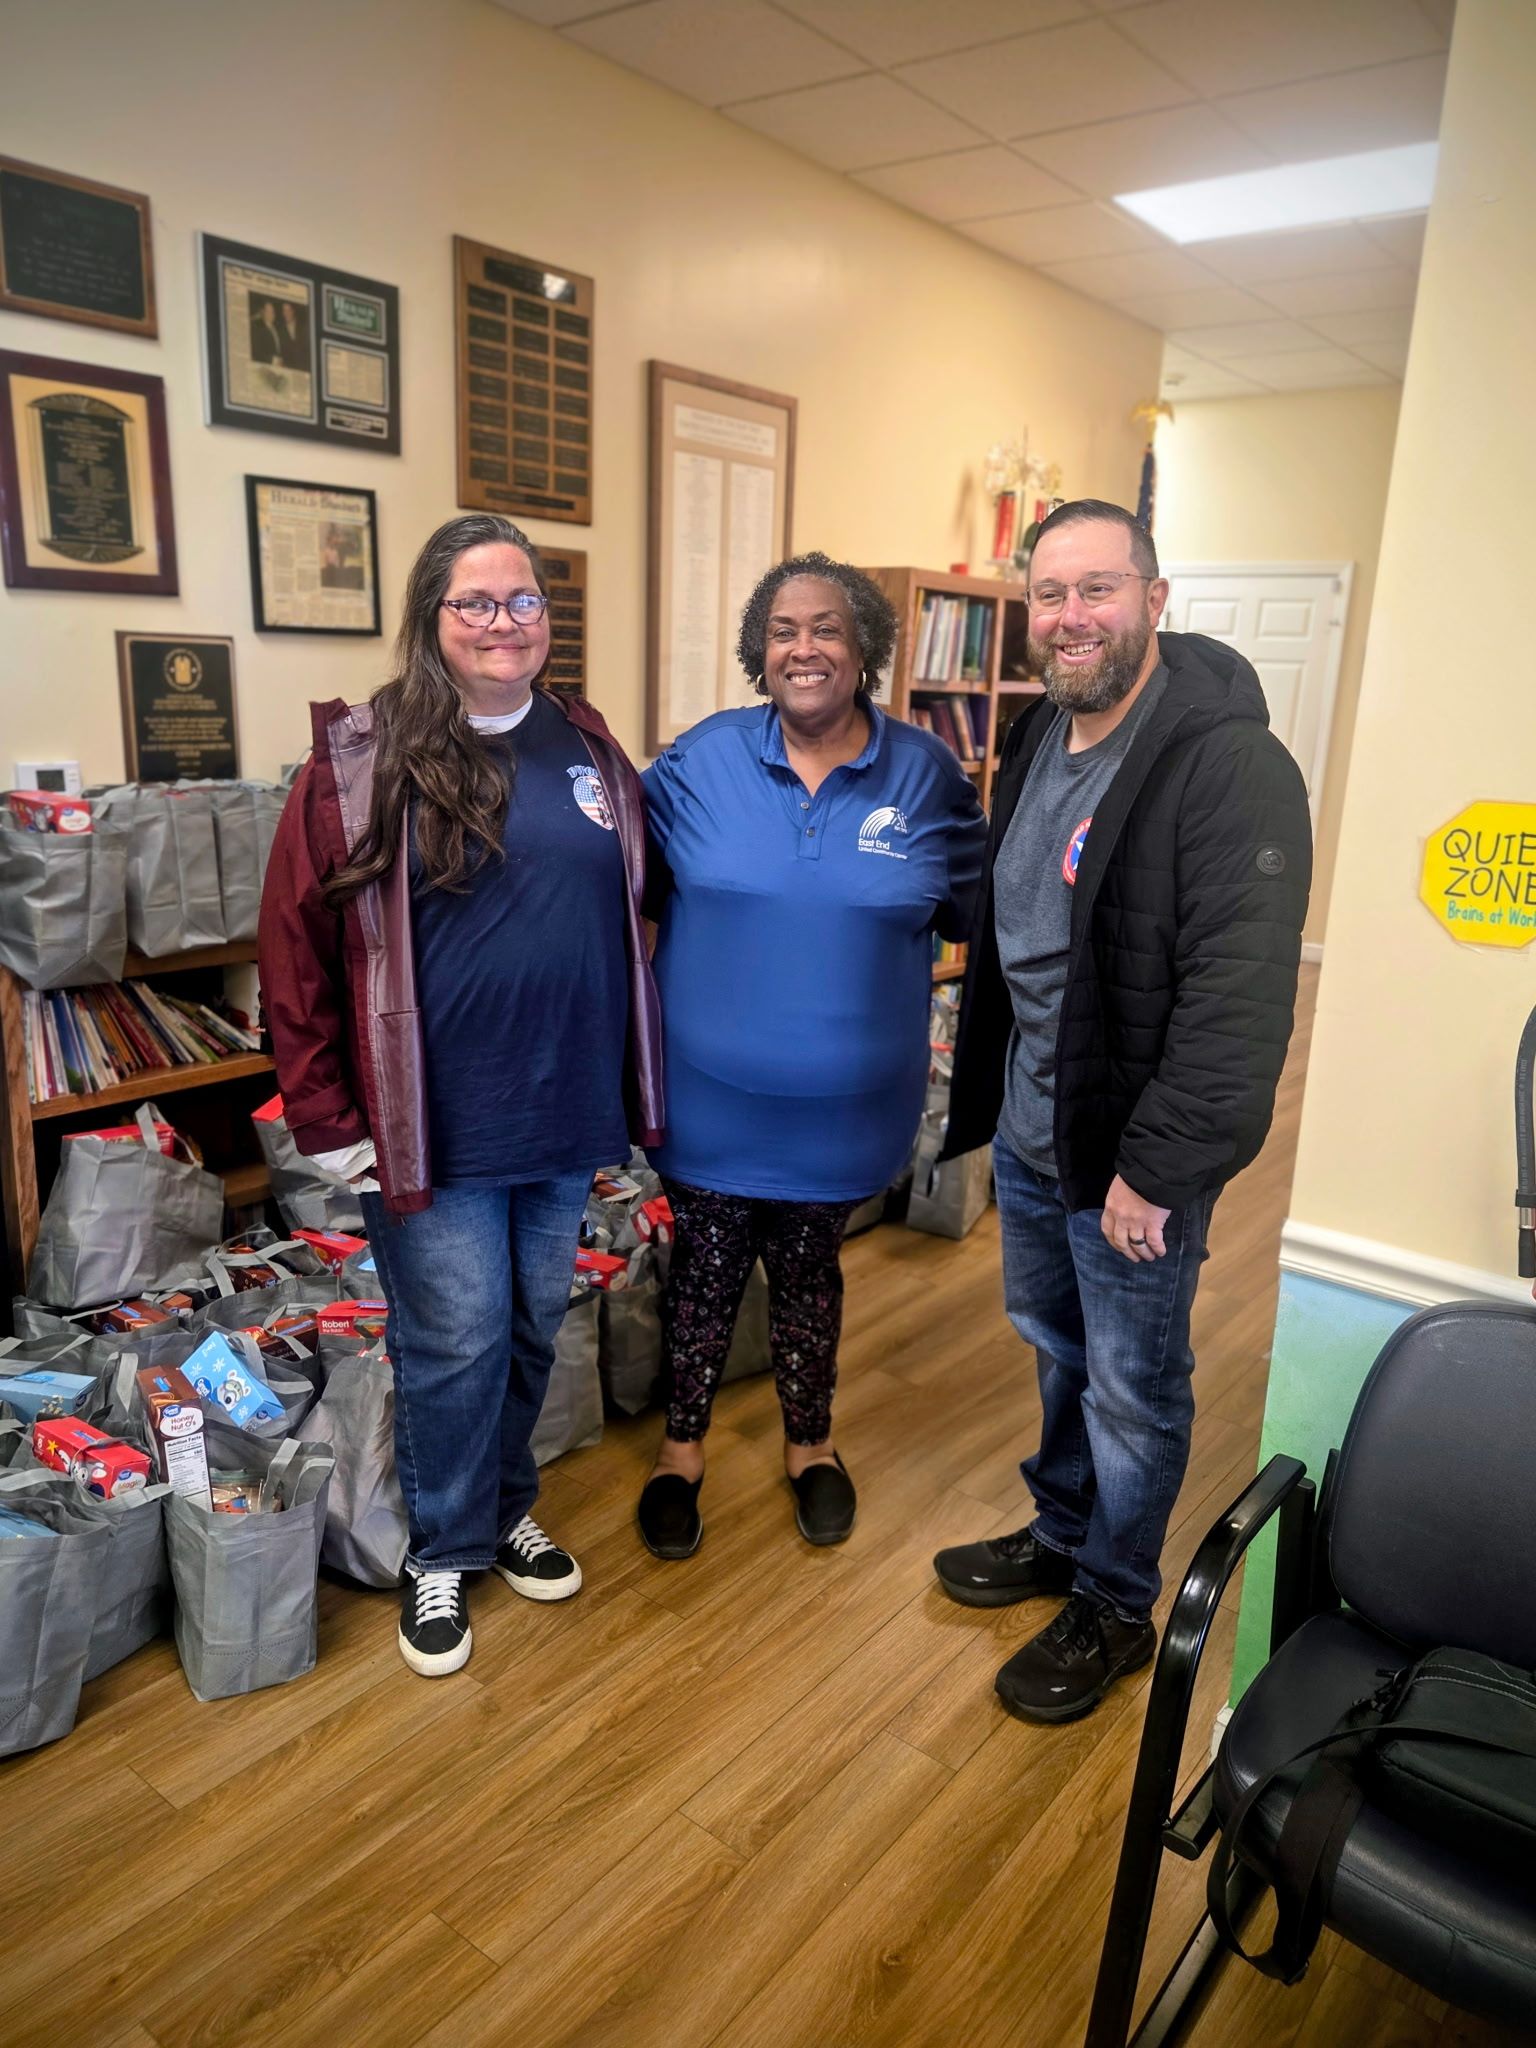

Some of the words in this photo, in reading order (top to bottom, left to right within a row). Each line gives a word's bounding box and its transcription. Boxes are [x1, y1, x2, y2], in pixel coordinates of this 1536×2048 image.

[858, 838, 874, 847] East
[876, 840, 890, 850] End
[1444, 867, 1536, 905] ZONE
[1447, 900, 1484, 922] Brains
[1489, 907, 1503, 924] at
[322, 1319, 350, 1329] Robert
[171, 1415, 195, 1424] Honey
[171, 1423, 184, 1431] Nut
